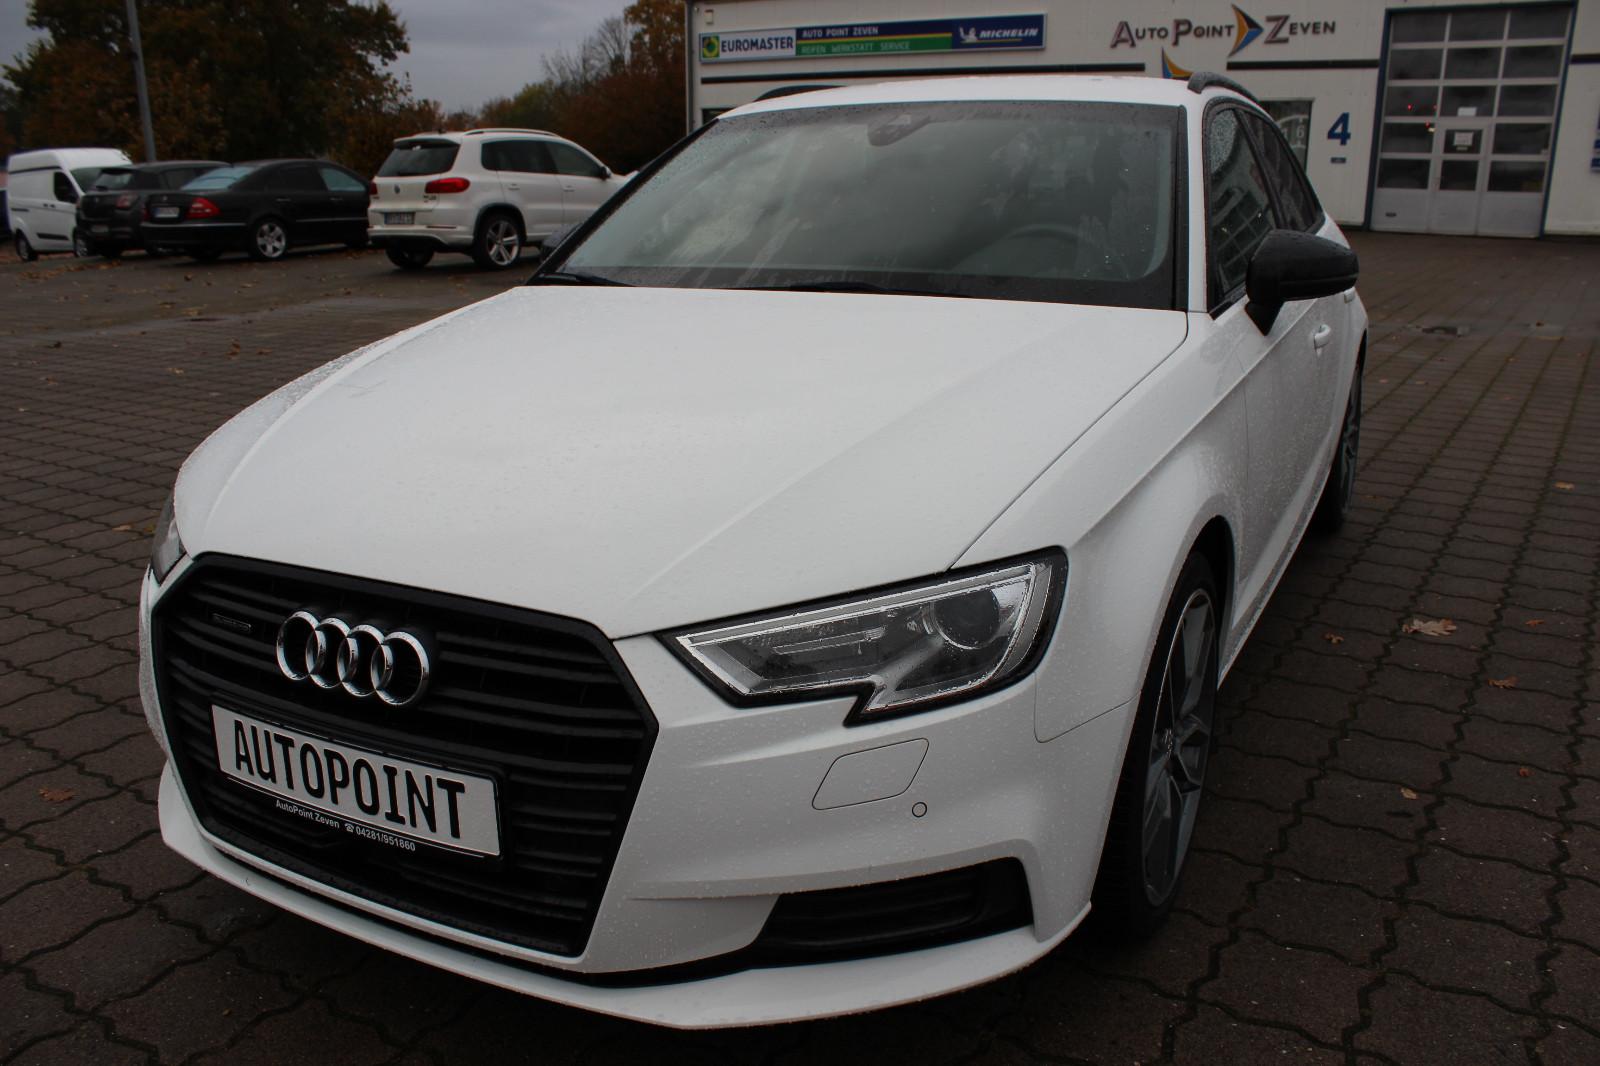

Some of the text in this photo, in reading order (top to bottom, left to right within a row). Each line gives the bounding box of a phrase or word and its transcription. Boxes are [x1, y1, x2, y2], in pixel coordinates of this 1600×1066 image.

[720, 35, 794, 53] EUROMASTER
[802, 26, 879, 38] AUTO POINT ZEVEN
[979, 27, 1039, 39] MICHELIN
[1327, 112, 1352, 146] 4
[234, 719, 466, 839] AUTOPOINT
[275, 799, 416, 852] AutoPoint Zeven 04281/951860
